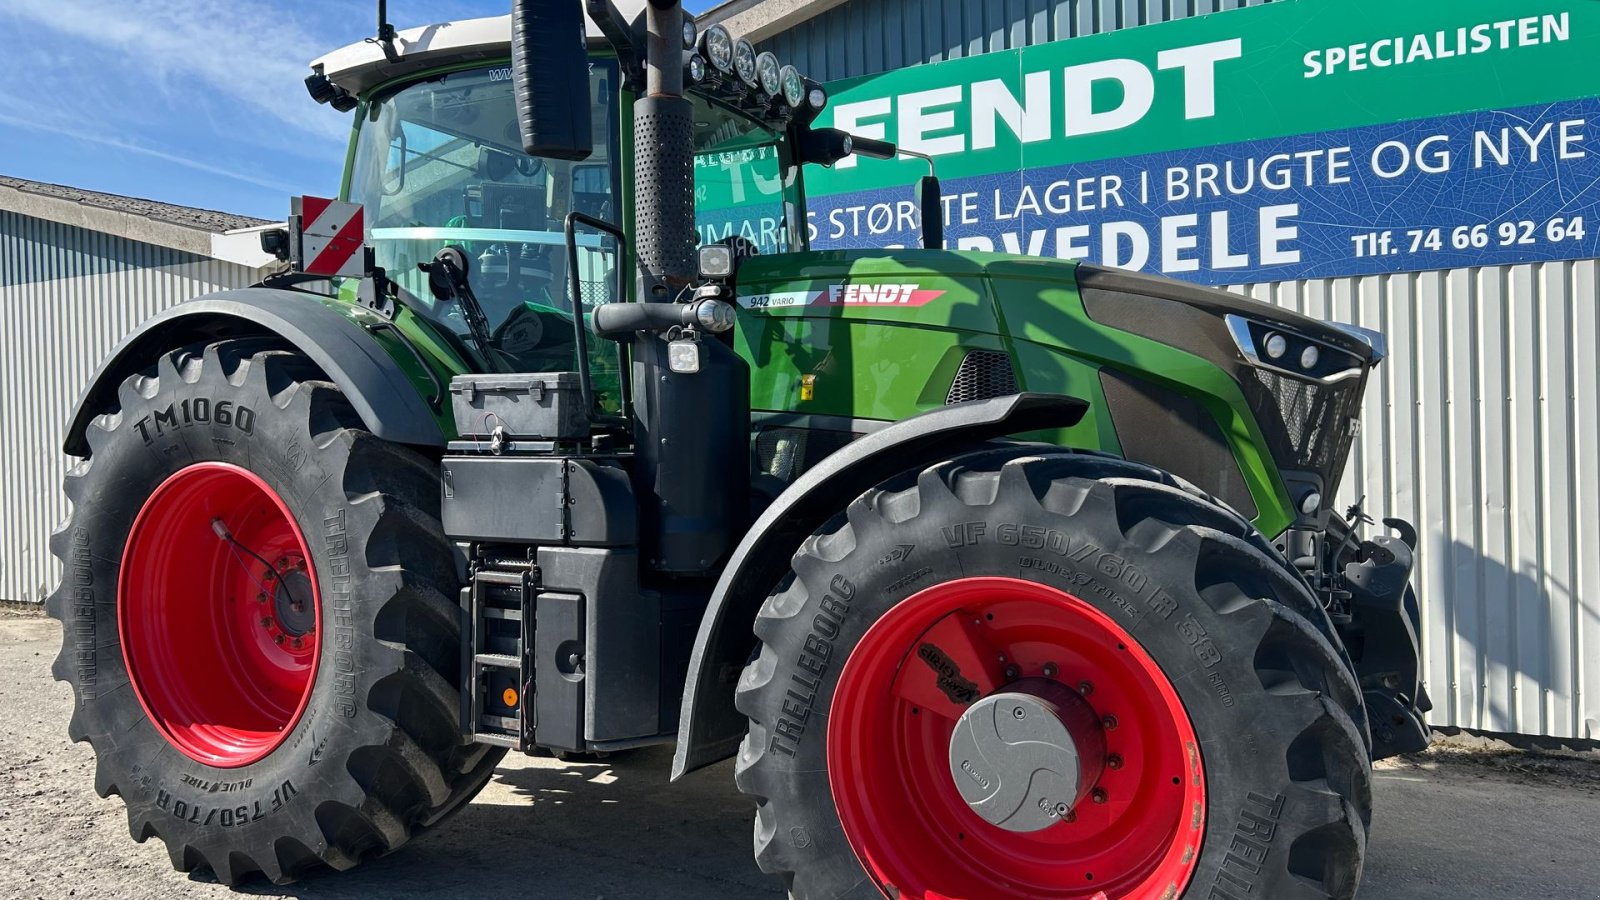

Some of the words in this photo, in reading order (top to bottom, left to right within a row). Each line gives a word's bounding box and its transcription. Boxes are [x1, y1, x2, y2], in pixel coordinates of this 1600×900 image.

[1303, 12, 1570, 78] SPECIALISTEN
[834, 38, 1242, 170] FENDT
[829, 192, 979, 240] STØRTE
[995, 174, 1124, 220] LAGER
[1141, 171, 1149, 203] I
[1168, 146, 1351, 201] BRUGTE
[1371, 135, 1450, 178] OG
[1475, 119, 1586, 168] NYE
[1351, 234, 1399, 258] Tlf.
[1407, 228, 1442, 253] 74
[1451, 224, 1489, 250] 66
[1498, 220, 1536, 246] 92
[1546, 216, 1586, 242] 64
[750, 296, 769, 308] 942
[771, 297, 795, 306] VARIO
[828, 284, 920, 304] FENDT
[133, 397, 257, 447] TM1060
[940, 520, 987, 549] VF
[994, 523, 1149, 594] 650/60
[73, 526, 97, 708] TRELLEBORG
[323, 508, 357, 718] TRELLEBORG
[769, 573, 857, 759] TRELLEBORG
